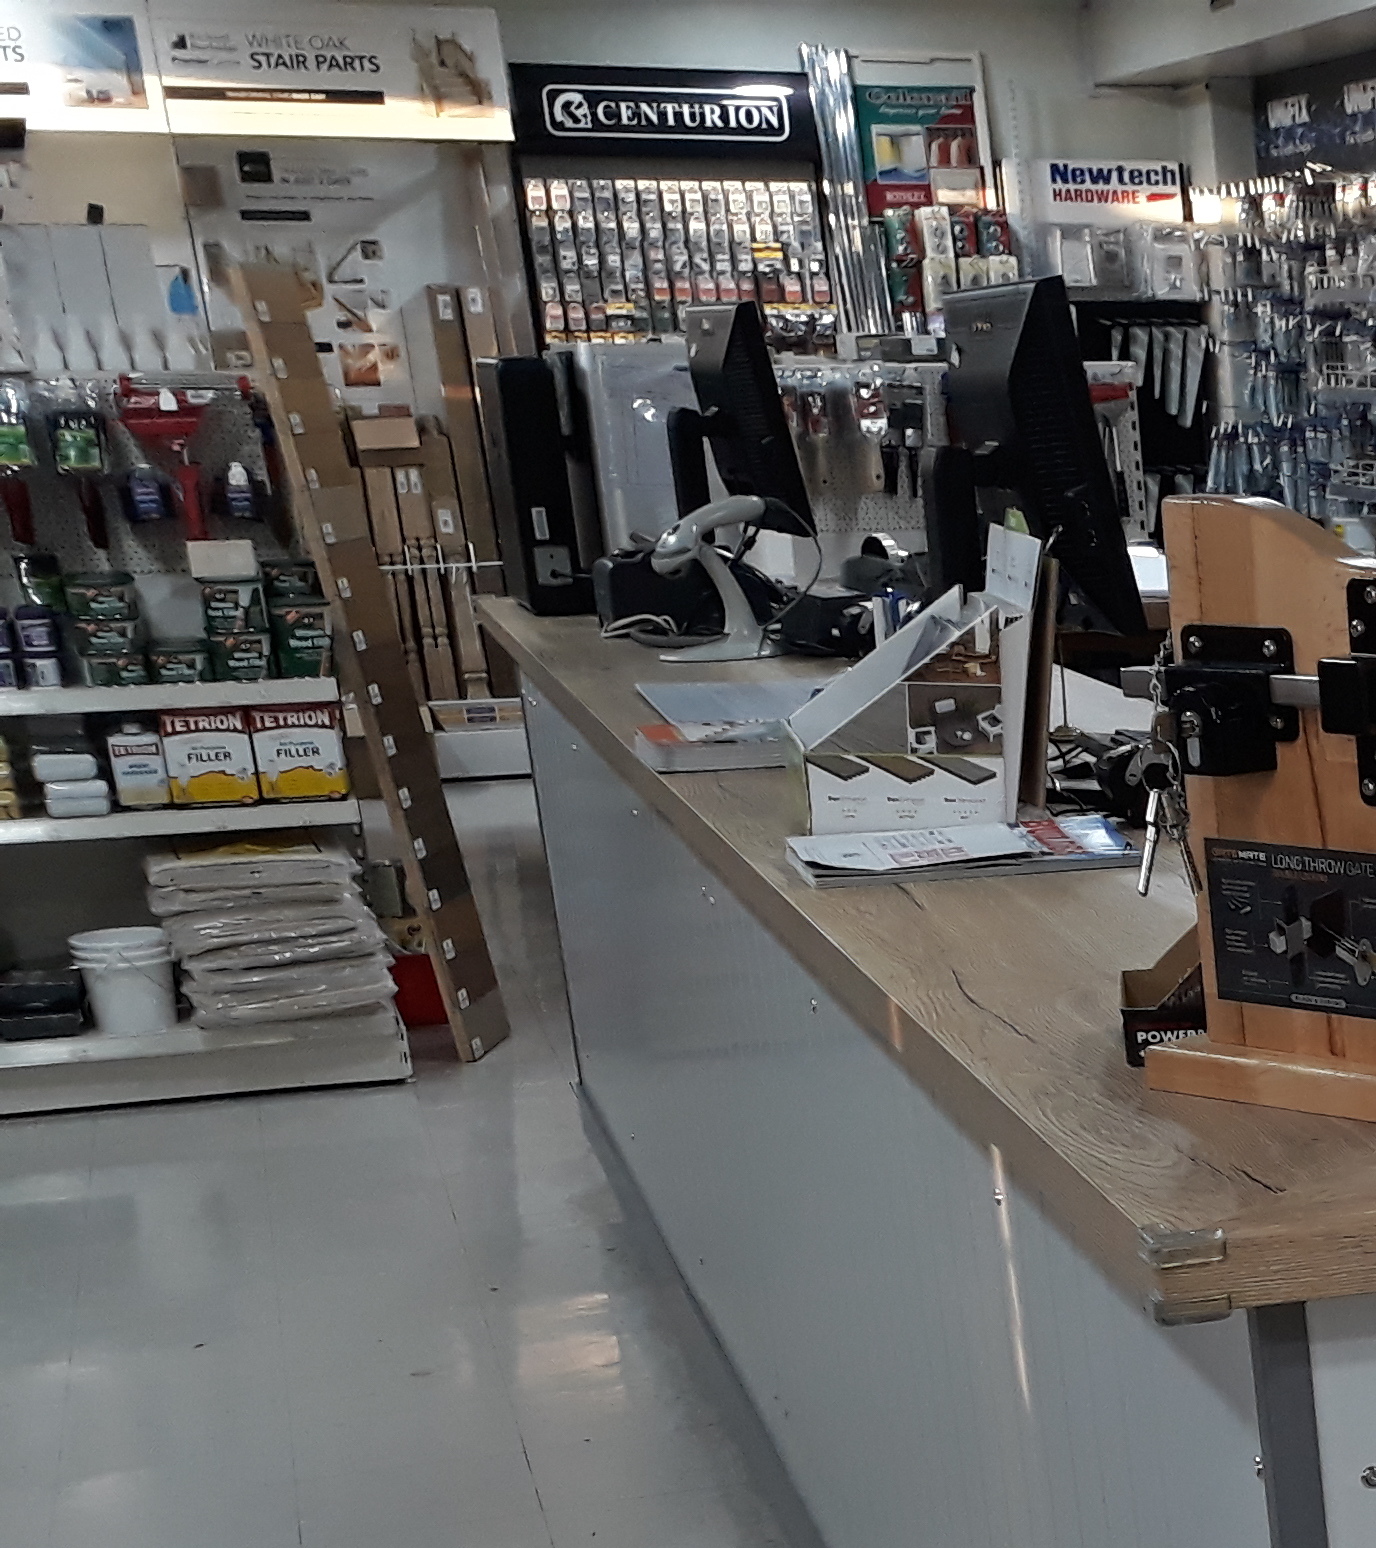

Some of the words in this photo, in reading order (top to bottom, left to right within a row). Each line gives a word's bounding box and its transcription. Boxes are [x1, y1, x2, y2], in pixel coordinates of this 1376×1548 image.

[244, 33, 300, 49] WHITE
[308, 34, 350, 51] OAK
[250, 51, 311, 72] STAIR
[314, 53, 381, 74] PARTS
[596, 100, 780, 131] CENTURION
[1049, 162, 1178, 187] Newtech
[1052, 187, 1141, 205] HARDWARE
[160, 711, 243, 735] TETRION
[252, 708, 332, 733] TETRION
[187, 750, 232, 765] FILLER
[276, 746, 321, 759] FILLER
[1271, 853, 1302, 872] LONG
[1303, 856, 1345, 875] THROW
[1346, 861, 1374, 879] GATE
